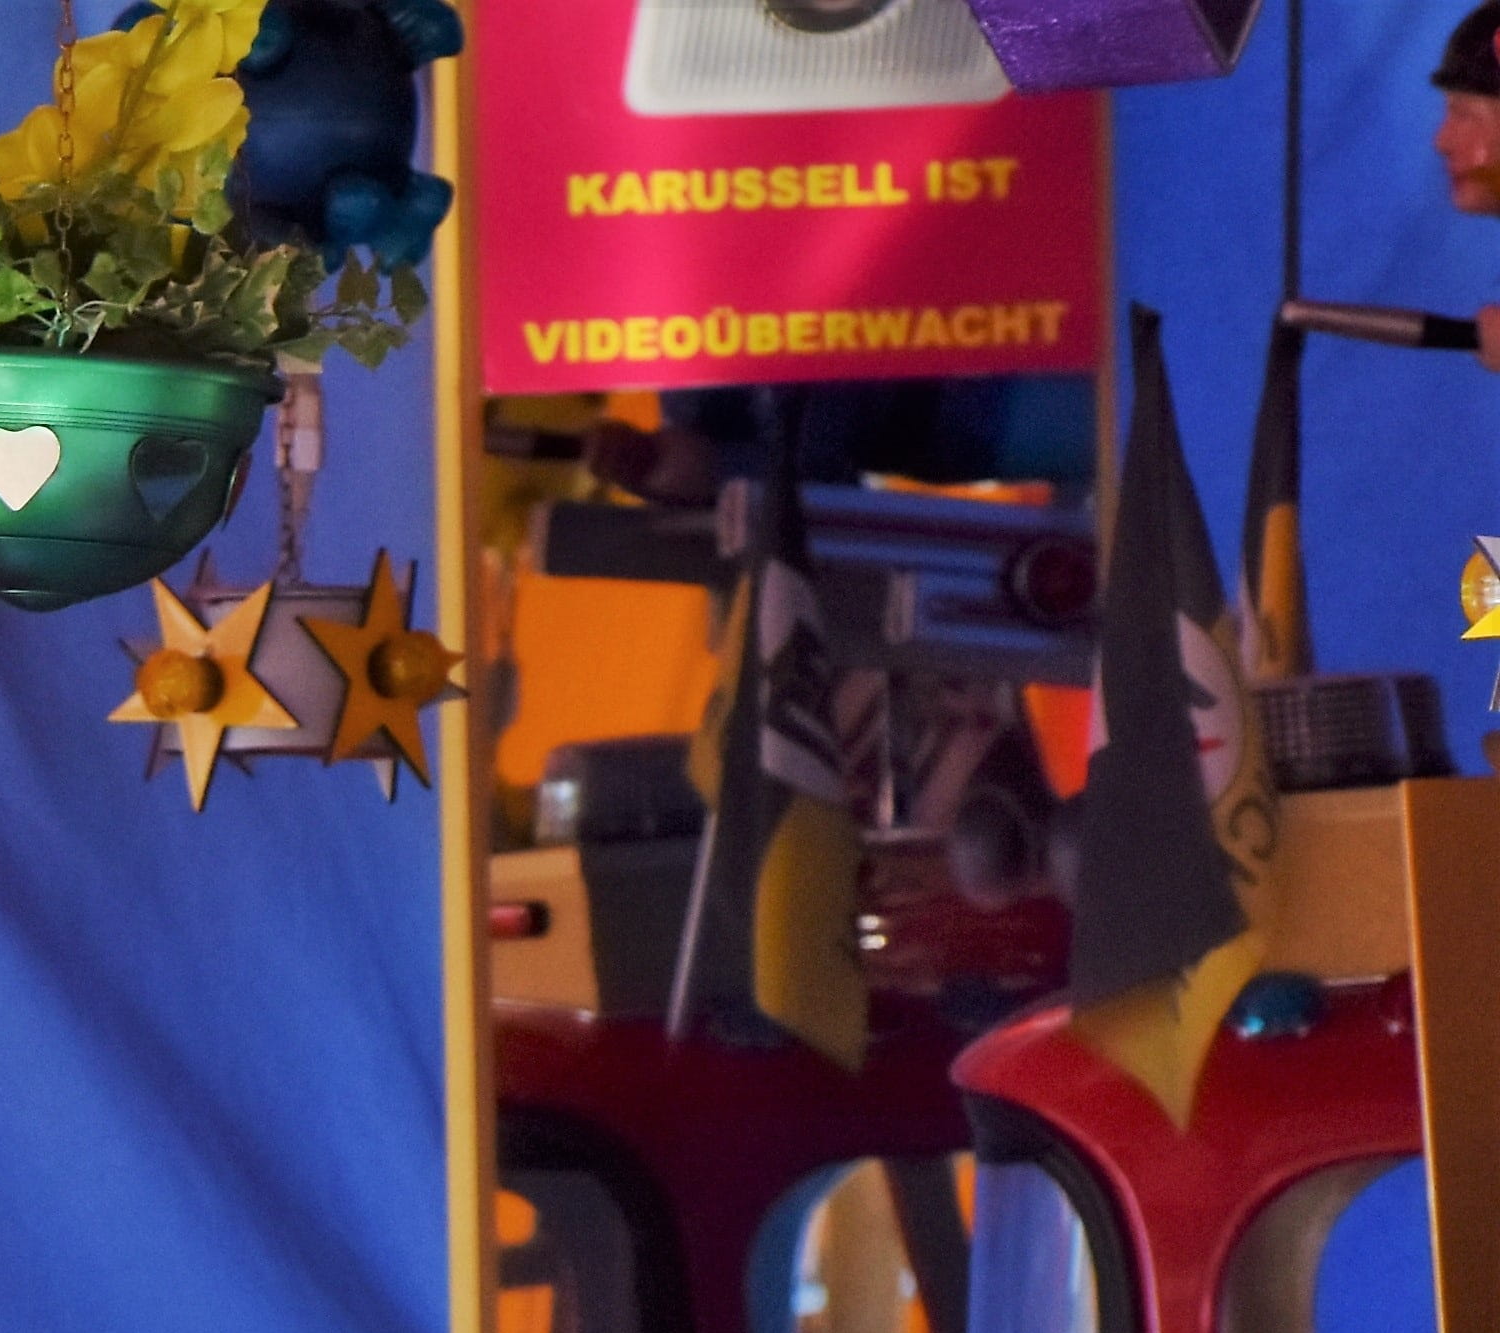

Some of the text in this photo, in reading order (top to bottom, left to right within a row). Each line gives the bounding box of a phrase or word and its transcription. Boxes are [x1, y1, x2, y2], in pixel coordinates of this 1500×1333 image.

[567, 158, 1018, 216] KARUSSELL IST
[523, 301, 1068, 363] VIDEOÜBERWACHT
